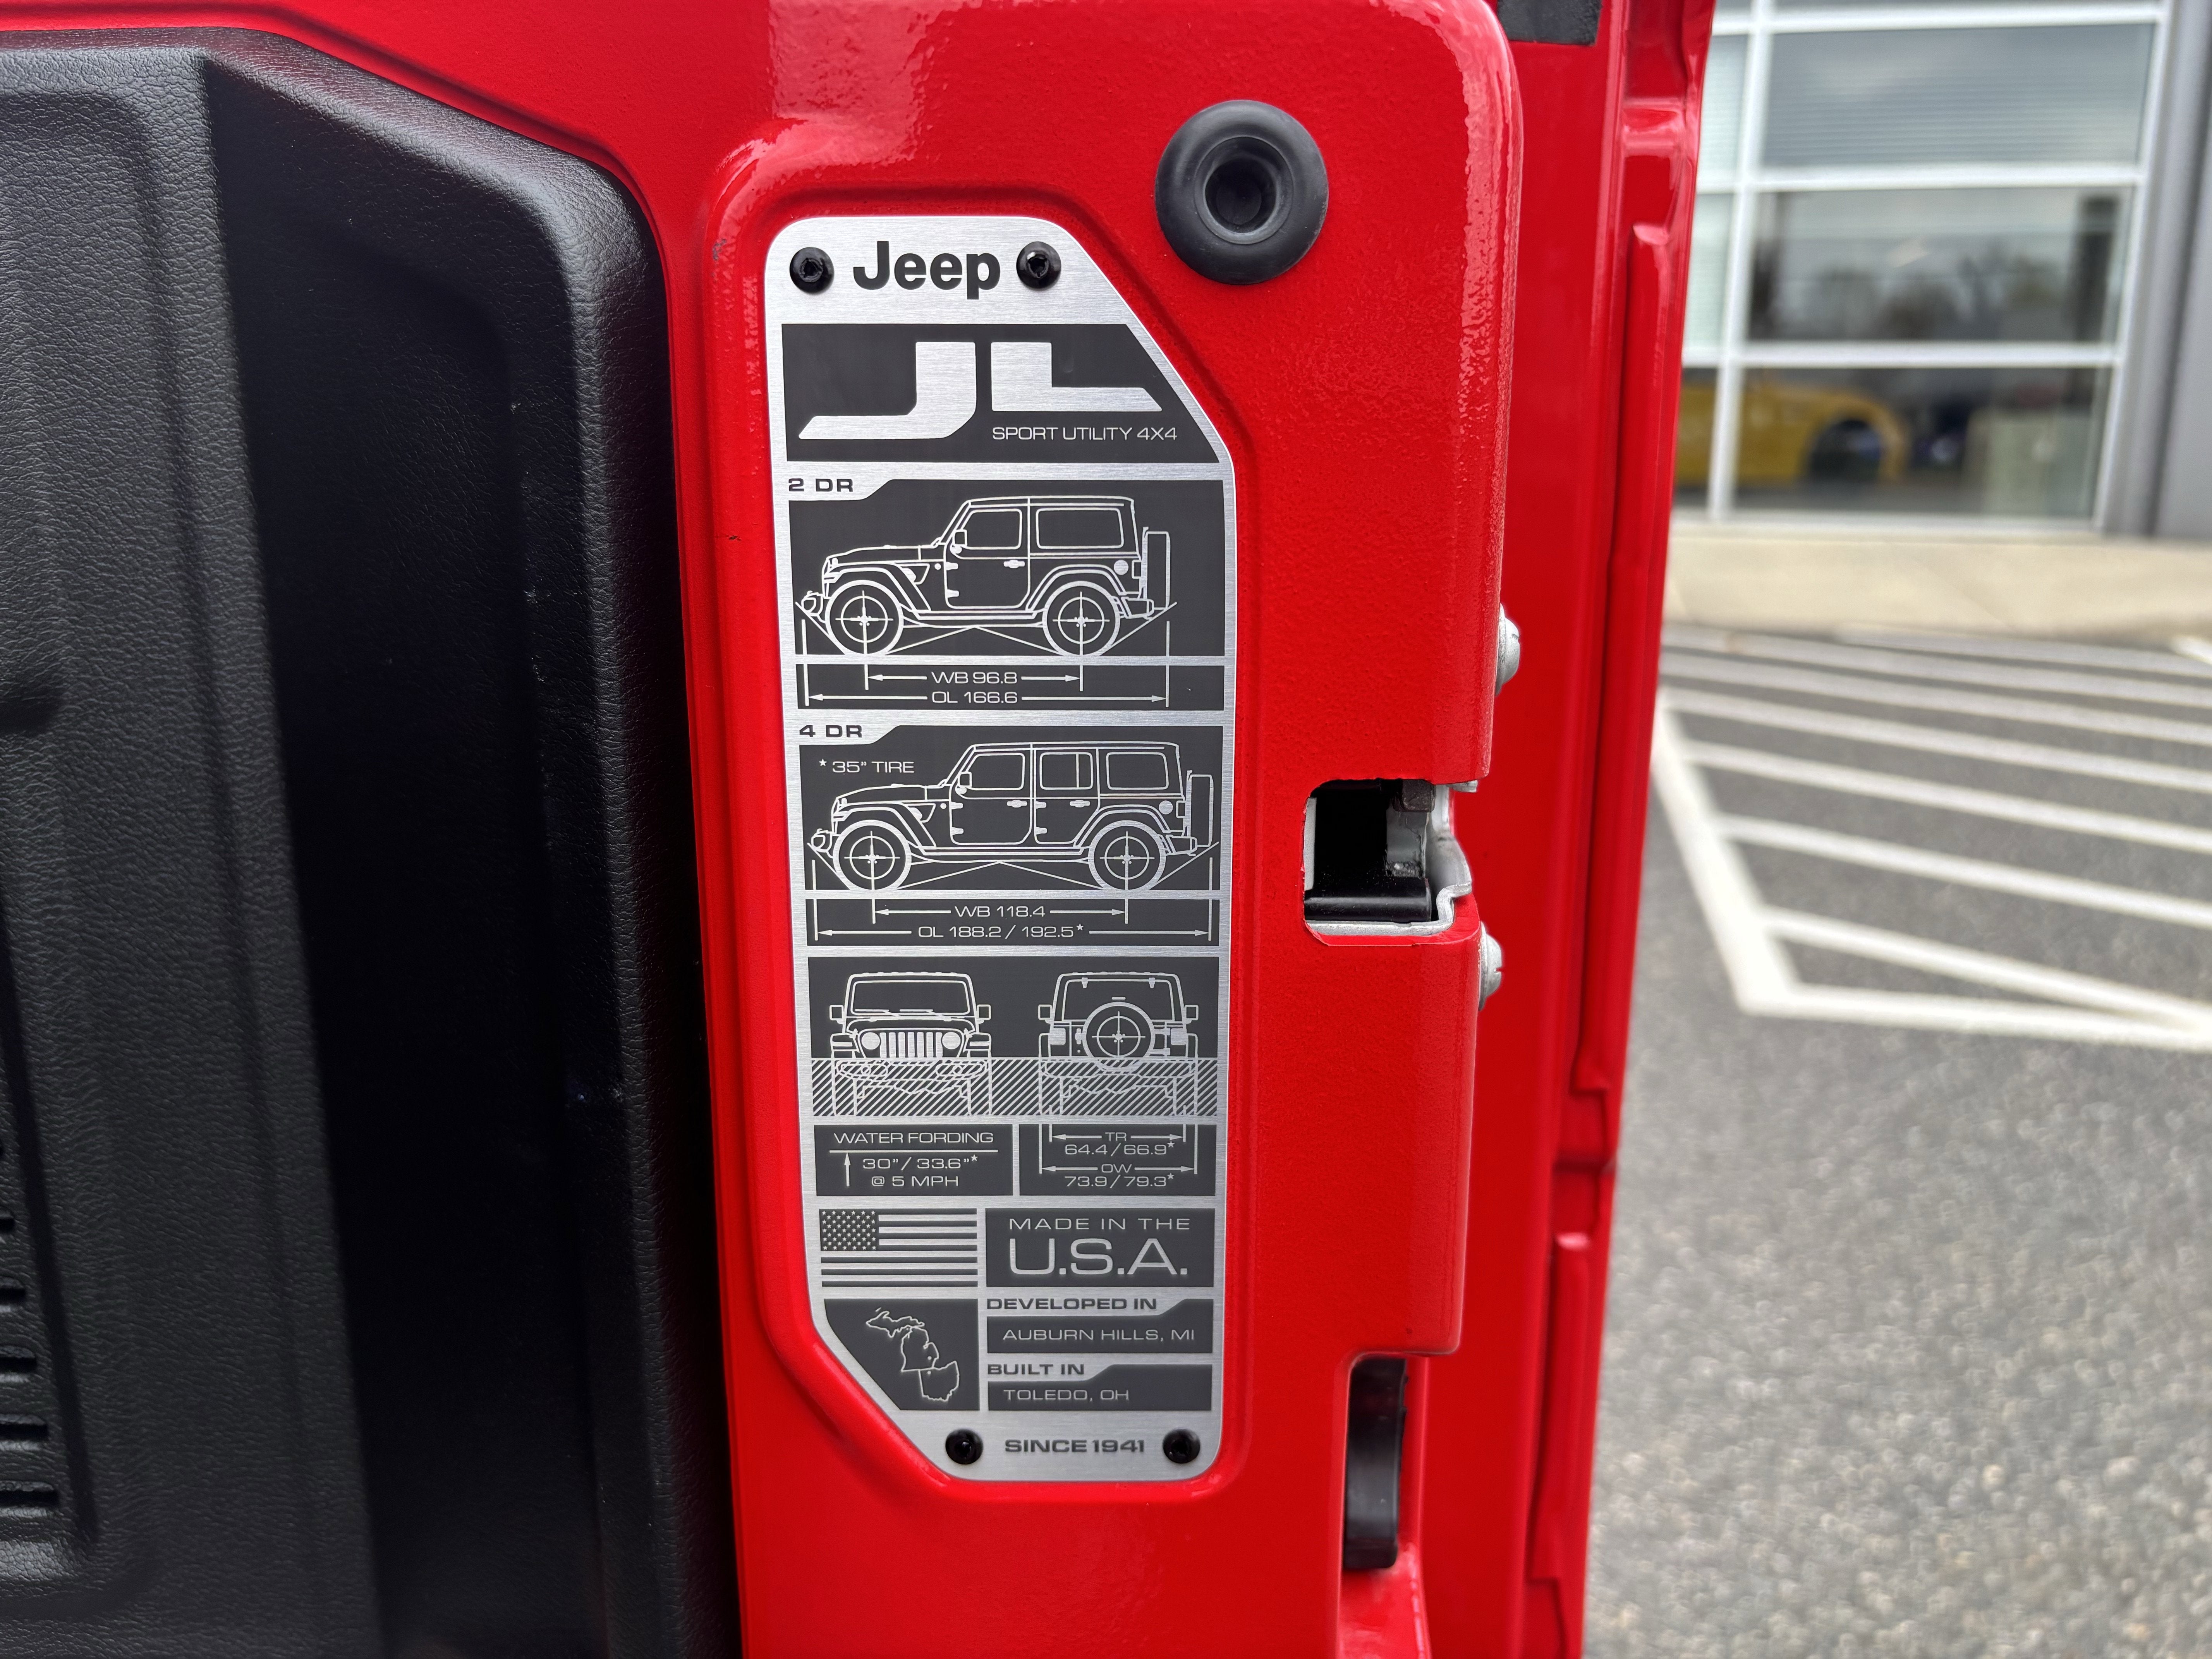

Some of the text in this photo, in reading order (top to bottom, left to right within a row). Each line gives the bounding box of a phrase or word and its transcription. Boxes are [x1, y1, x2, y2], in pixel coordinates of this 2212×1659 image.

[853, 241, 1000, 299] Jeep
[799, 342, 1162, 440] JL
[993, 427, 1177, 440] SPORT UTILITY 4X4
[788, 478, 853, 492] 2 DR
[931, 672, 1017, 684] WB 96.8
[932, 692, 1017, 703] OL 166.6
[799, 725, 862, 737] 4 DR
[872, 762, 914, 773] TIRE
[955, 906, 1045, 917] WB 118.4
[919, 927, 943, 937] OL
[950, 927, 1001, 937] 188.2
[834, 1133, 993, 1143] WATER FORDING
[1105, 1132, 1127, 1142] TR
[1101, 1164, 1132, 1174] OW
[872, 1176, 958, 1186] @ 5 MPH
[1010, 1218, 1190, 1230] MADE IN THE
[1010, 1238, 1187, 1274] U.S.A.
[987, 1298, 1156, 1309] DEVELOPED IN
[1003, 1330, 1194, 1341] AUBURN HILLS, MI
[988, 1364, 1084, 1375] BUILT IN
[1004, 1390, 1128, 1401] TOLEDO, OH
[1005, 1440, 1144, 1453] SINCE 1941
